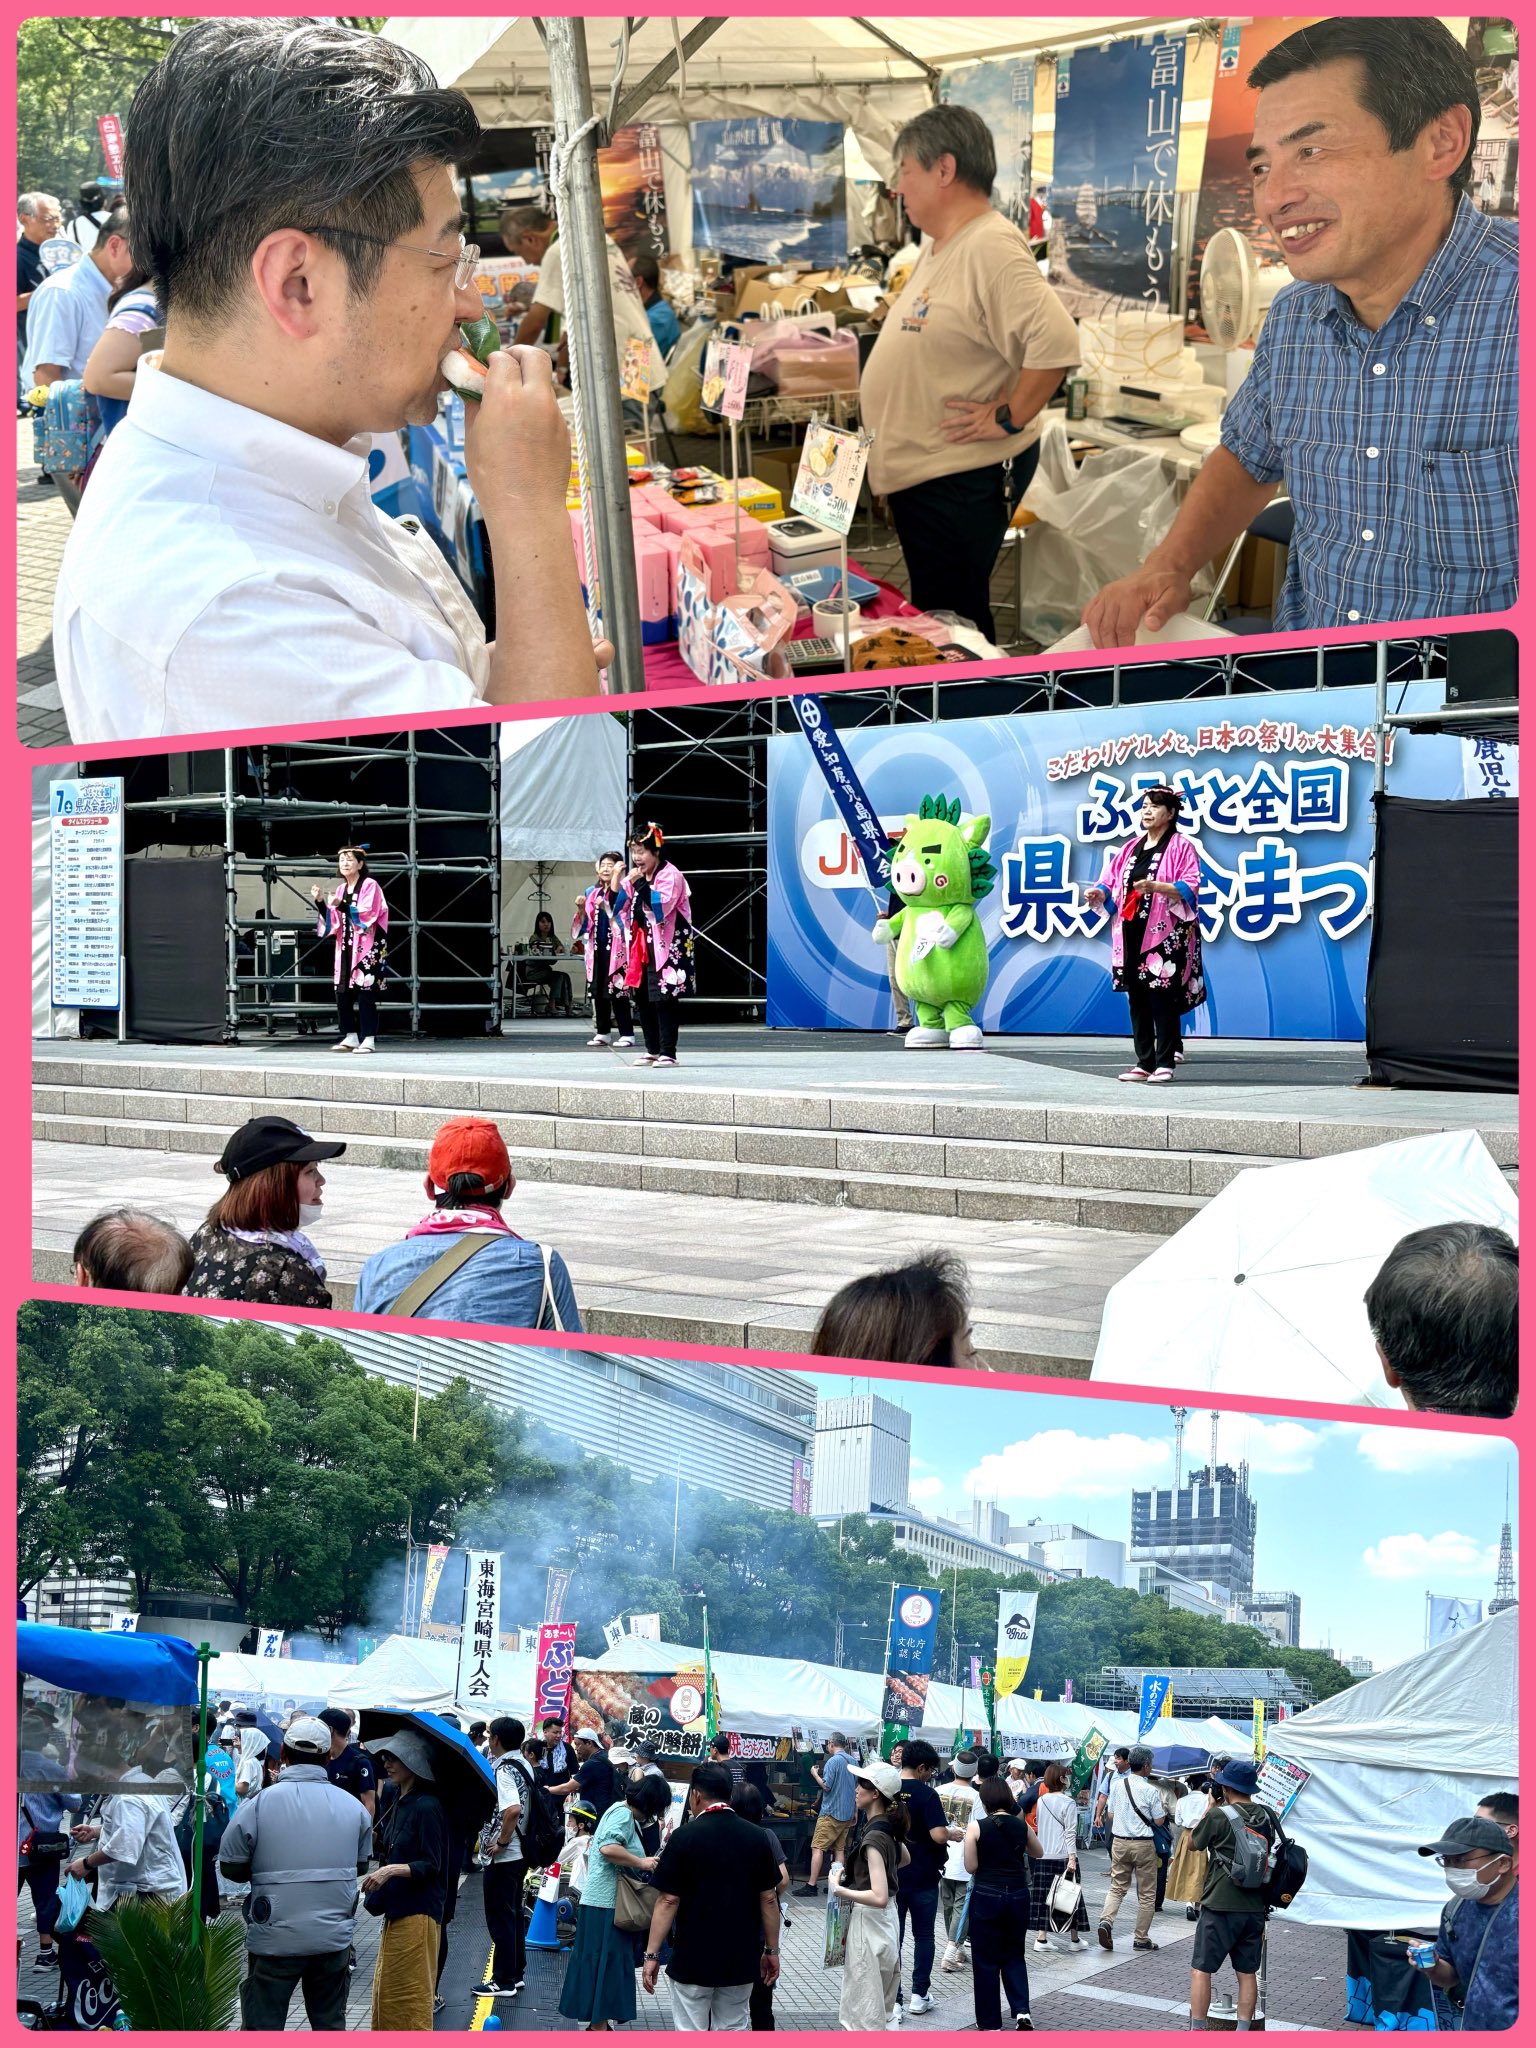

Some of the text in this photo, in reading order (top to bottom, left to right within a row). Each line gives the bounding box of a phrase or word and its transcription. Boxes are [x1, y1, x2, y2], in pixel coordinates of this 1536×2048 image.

[1140, 37, 1183, 312] 富山で休もう
[56, 790, 64, 813] 7
[75, 797, 119, 814] 県人会まつり
[467, 1558, 496, 1698] 東海宮崎県人会
[897, 1636, 926, 1650] 文化庁
[629, 1706, 659, 1725] 蔵の
